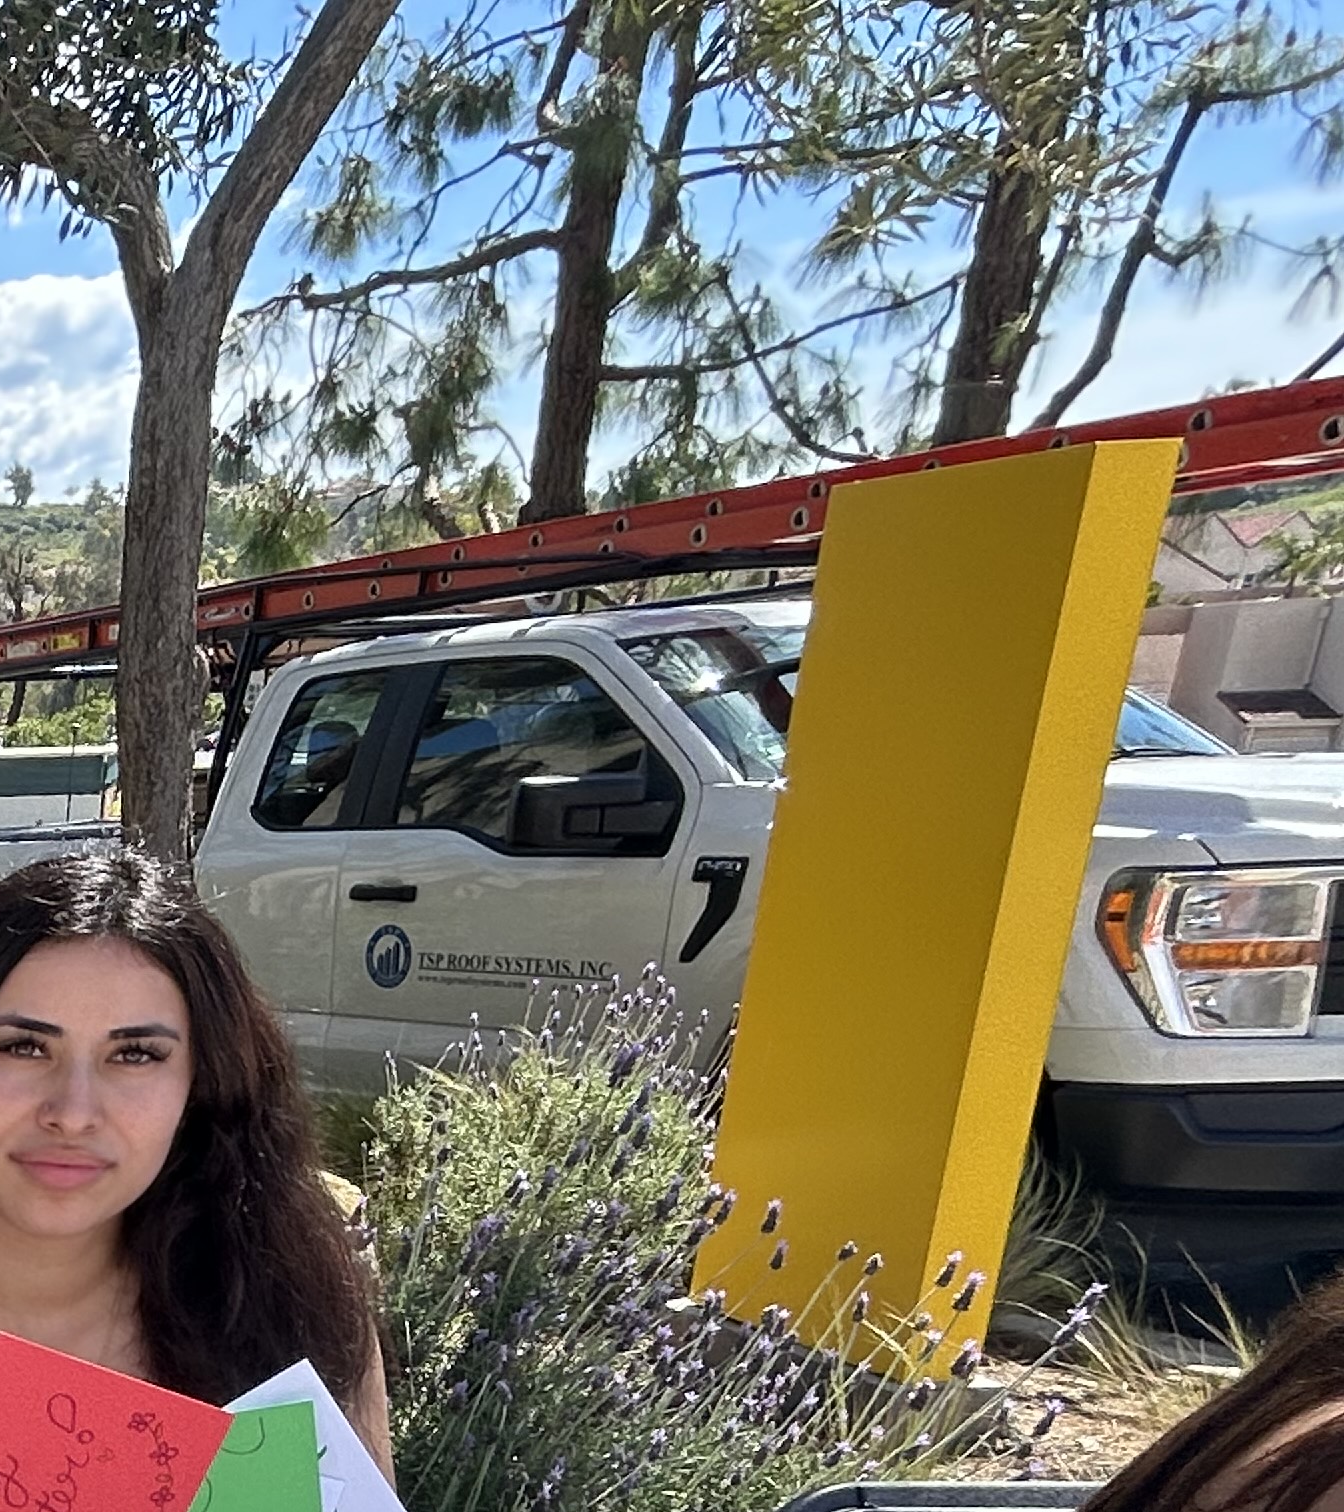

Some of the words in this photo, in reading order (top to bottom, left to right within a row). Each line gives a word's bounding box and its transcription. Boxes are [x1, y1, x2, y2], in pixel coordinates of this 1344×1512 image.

[417, 952, 444, 969] TSP
[447, 954, 492, 971] ROOF
[494, 956, 575, 978] SYSTEMS,
